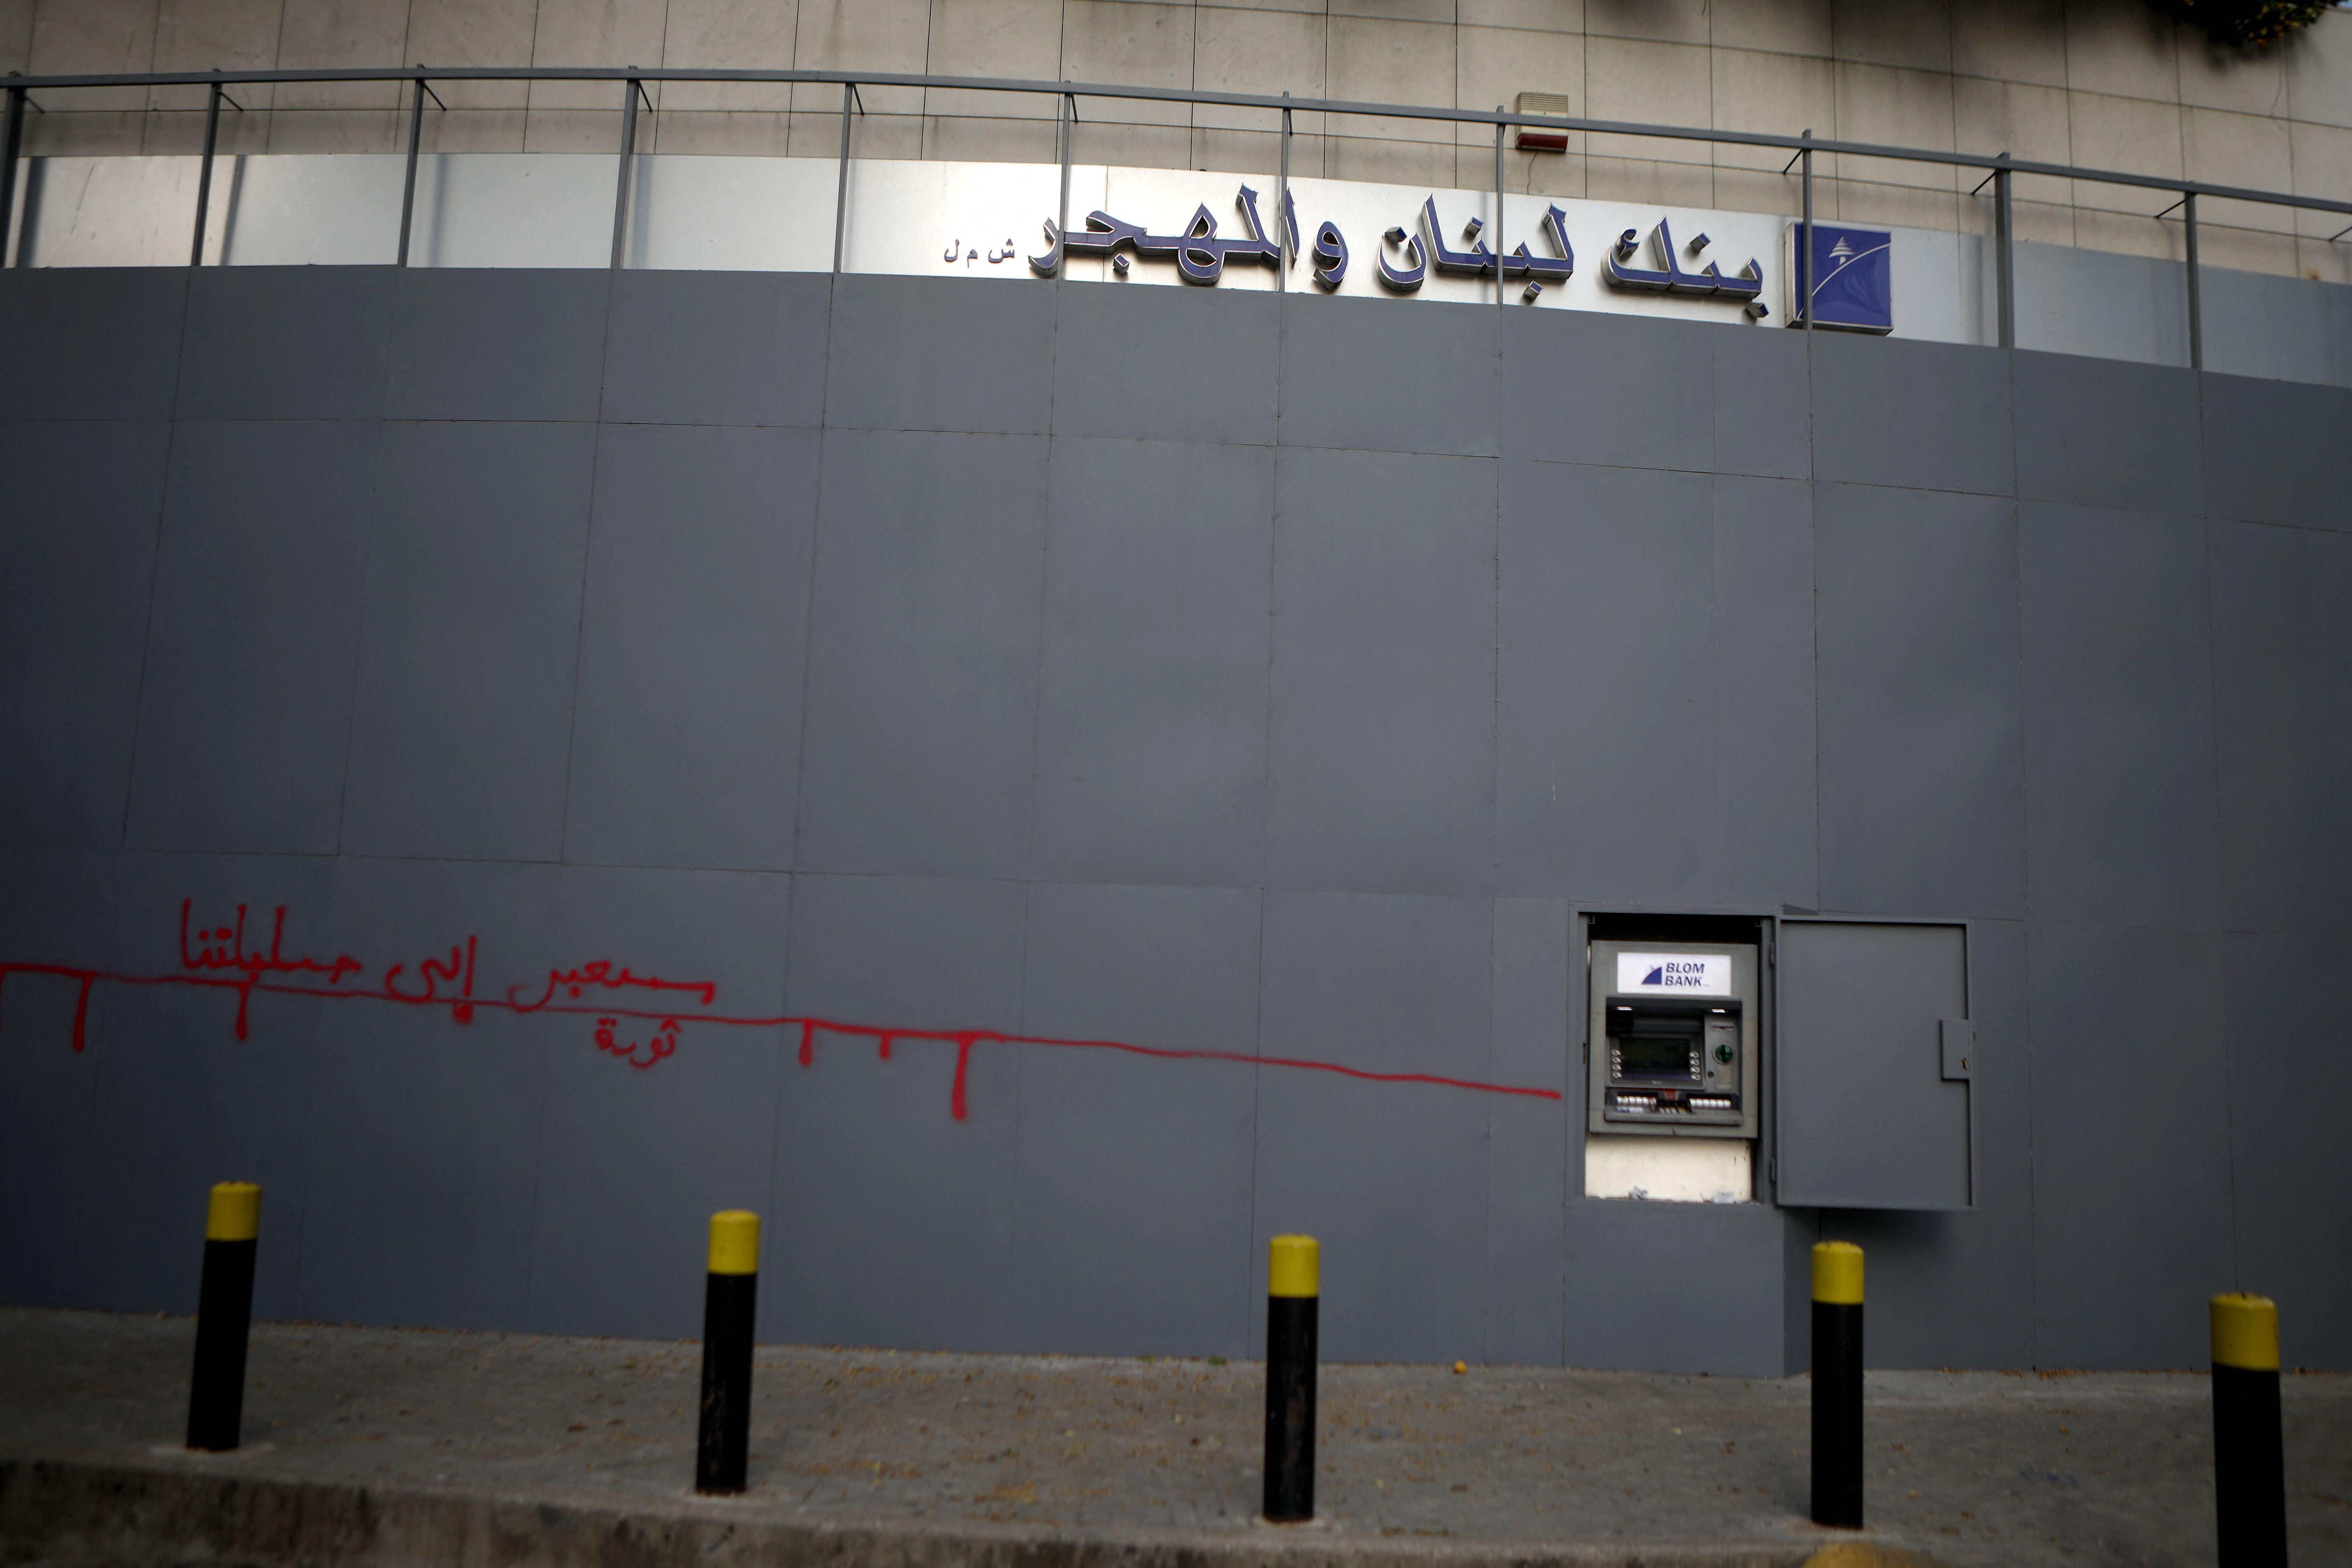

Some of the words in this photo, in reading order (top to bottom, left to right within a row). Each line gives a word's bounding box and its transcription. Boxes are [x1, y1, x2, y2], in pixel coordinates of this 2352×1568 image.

[1376, 192, 1574, 301] لبنان
[1602, 215, 1770, 318] بنك
[1665, 975, 1703, 987] BANK
[1666, 962, 1705, 974] BLOM
